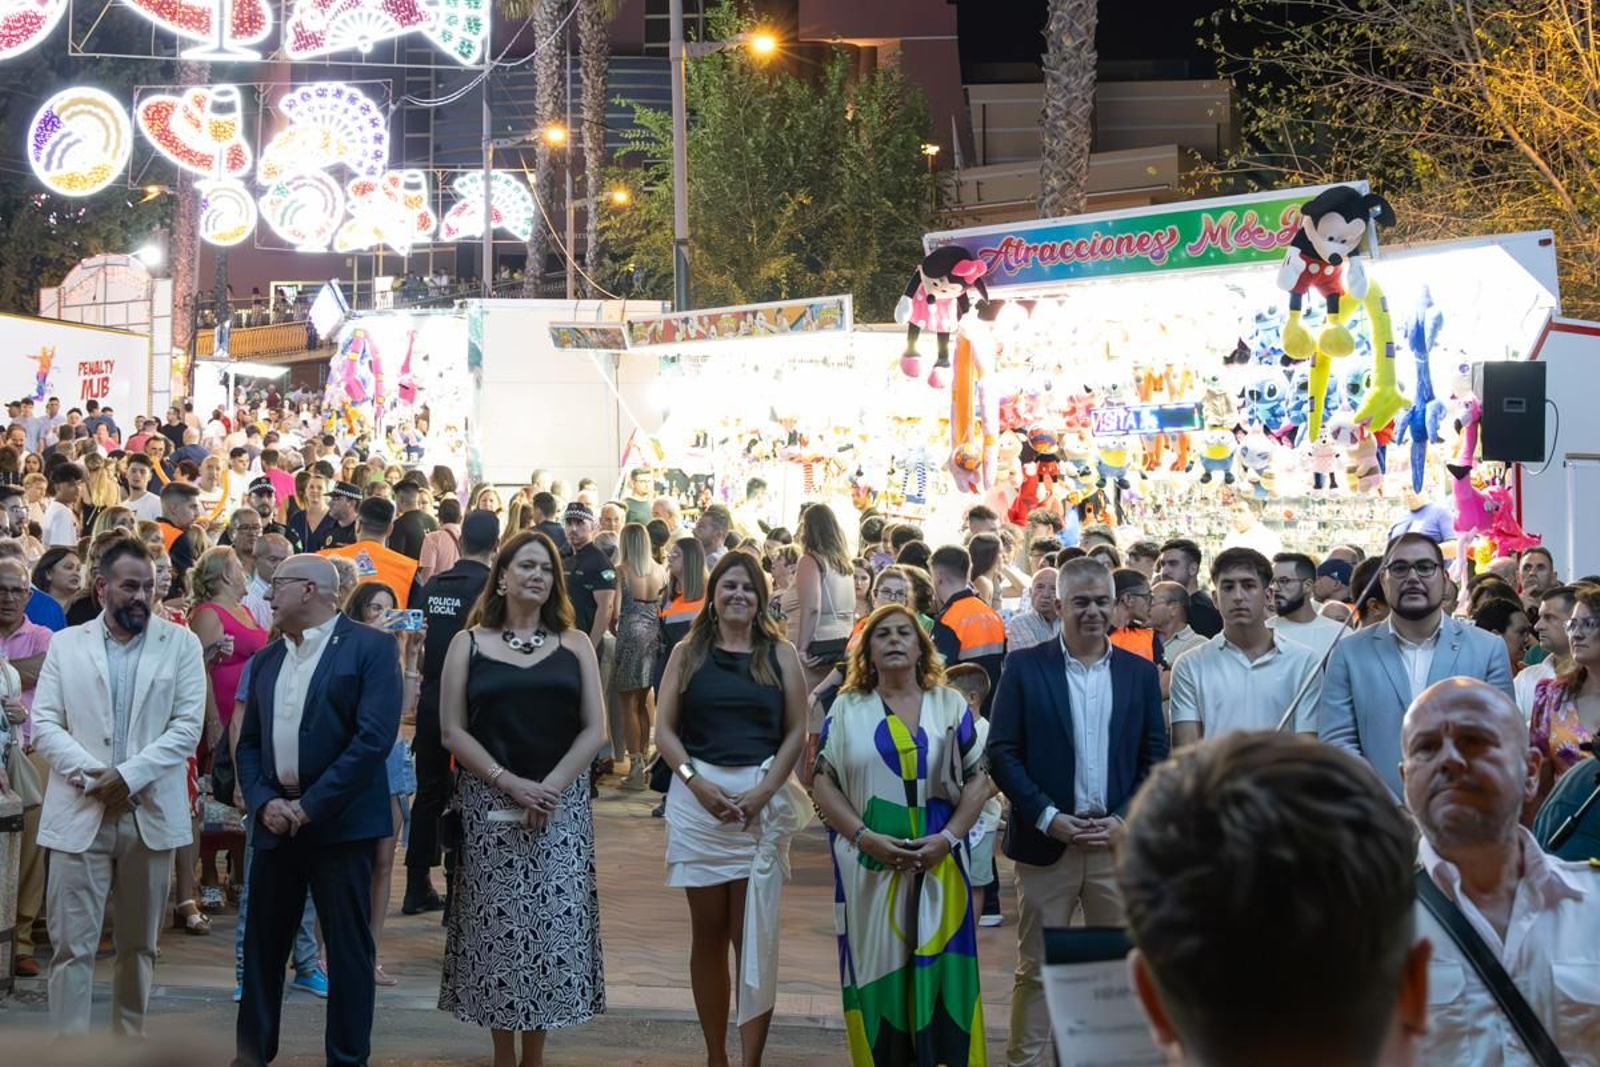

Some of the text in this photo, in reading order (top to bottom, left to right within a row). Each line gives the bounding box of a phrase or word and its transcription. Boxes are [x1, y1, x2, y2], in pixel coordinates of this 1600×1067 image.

[979, 226, 1180, 276] Atracciones
[78, 359, 115, 376] PENALTY
[80, 376, 110, 400] MJB
[429, 604, 457, 616] LOCAL
